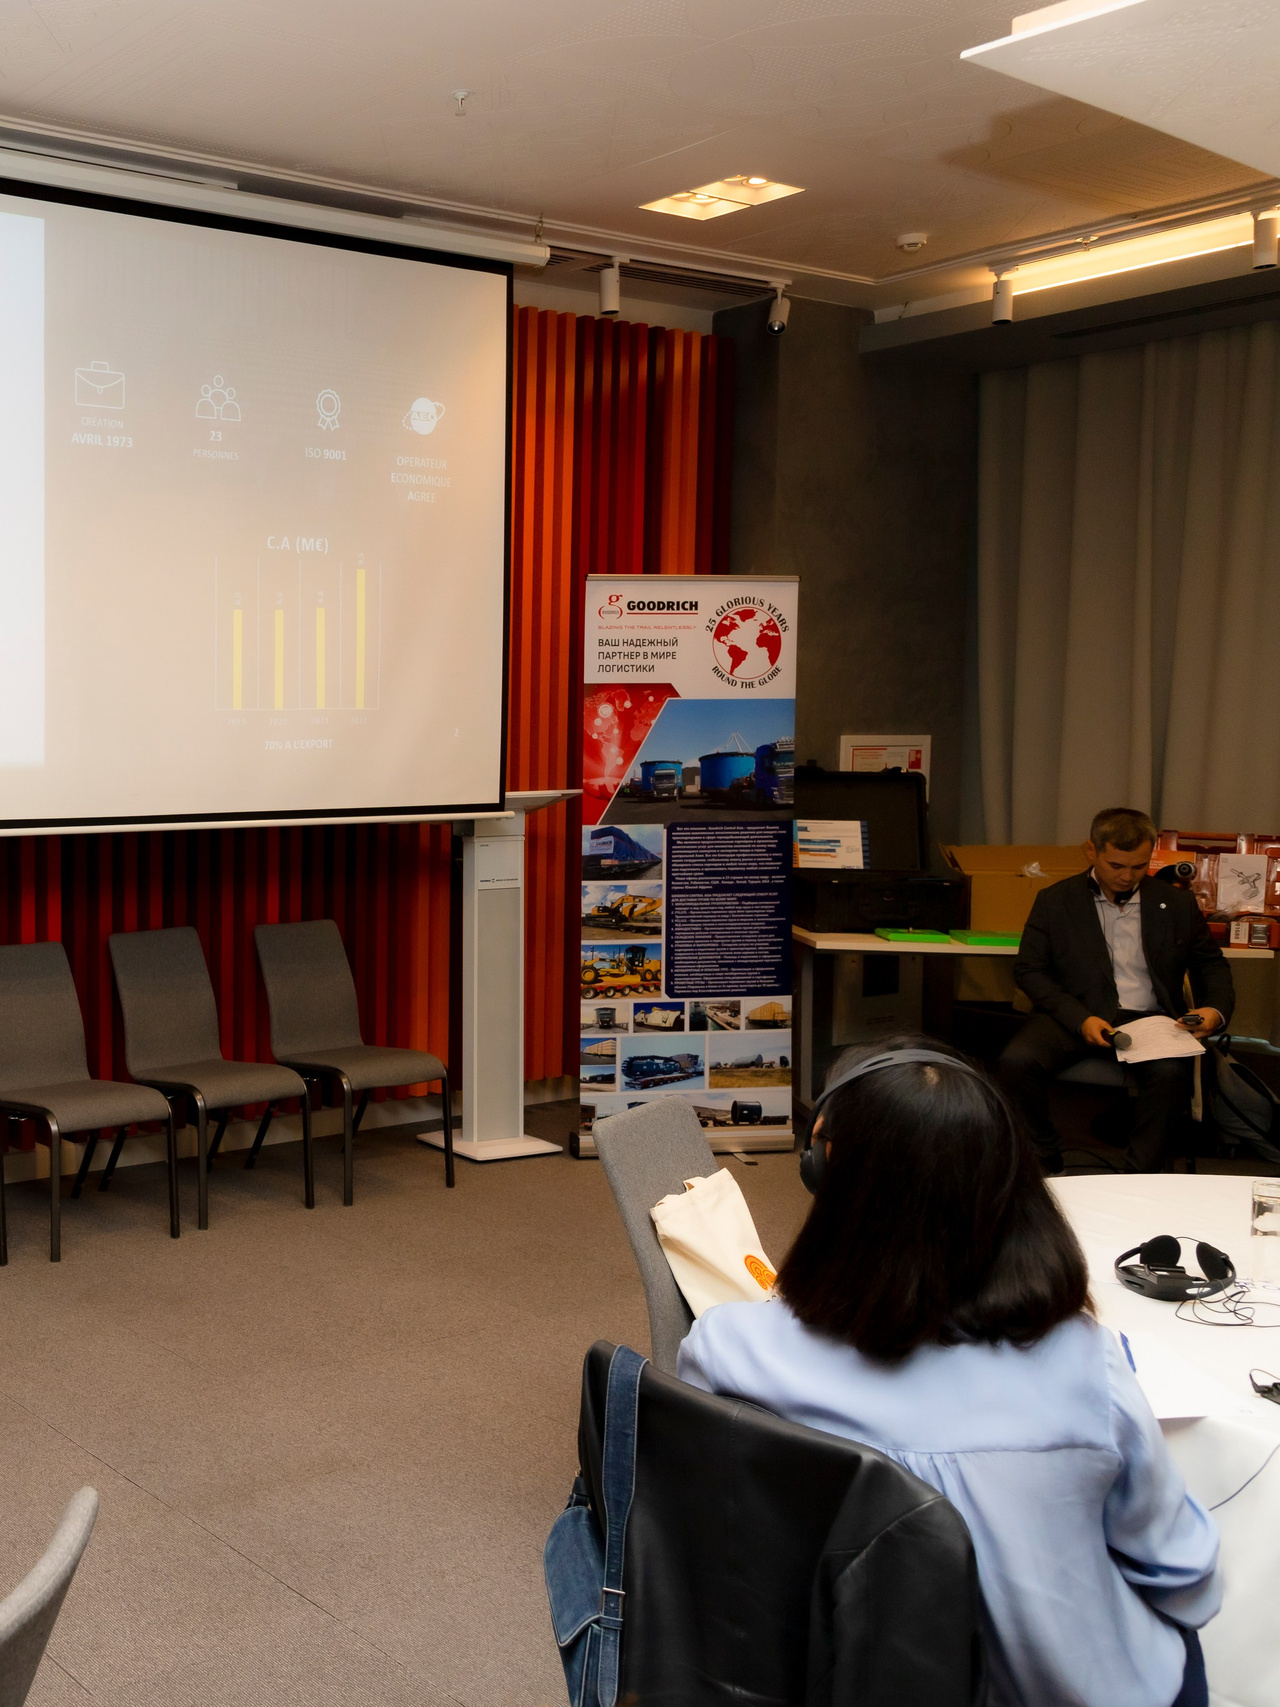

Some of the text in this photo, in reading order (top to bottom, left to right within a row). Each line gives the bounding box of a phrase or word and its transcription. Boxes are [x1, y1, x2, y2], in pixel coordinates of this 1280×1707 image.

[80, 416, 124, 430] CRÉATION
[71, 433, 133, 450] AVRIL 1973
[209, 430, 222, 442] 23
[192, 448, 239, 462] PERSONNES
[305, 447, 346, 461] ISO 9001
[396, 456, 448, 471] OPERATEUR
[390, 472, 452, 488] ECONOMIQUE
[266, 536, 329, 554] C.A (M€)
[626, 600, 698, 611] GOODRICH
[705, 596, 790, 633] 25 GLORIOUS YEARS
[598, 636, 678, 648] ВАШ НАДЕЖНЫЙ
[598, 651, 677, 660] ПАРТНЕР В МИРЕ
[597, 664, 654, 672] ЛОГИСТИКИ
[712, 666, 782, 689] ROUND THE GLOBE
[454, 728, 459, 738] 2
[264, 739, 334, 750] 70% A L'EXPORT
